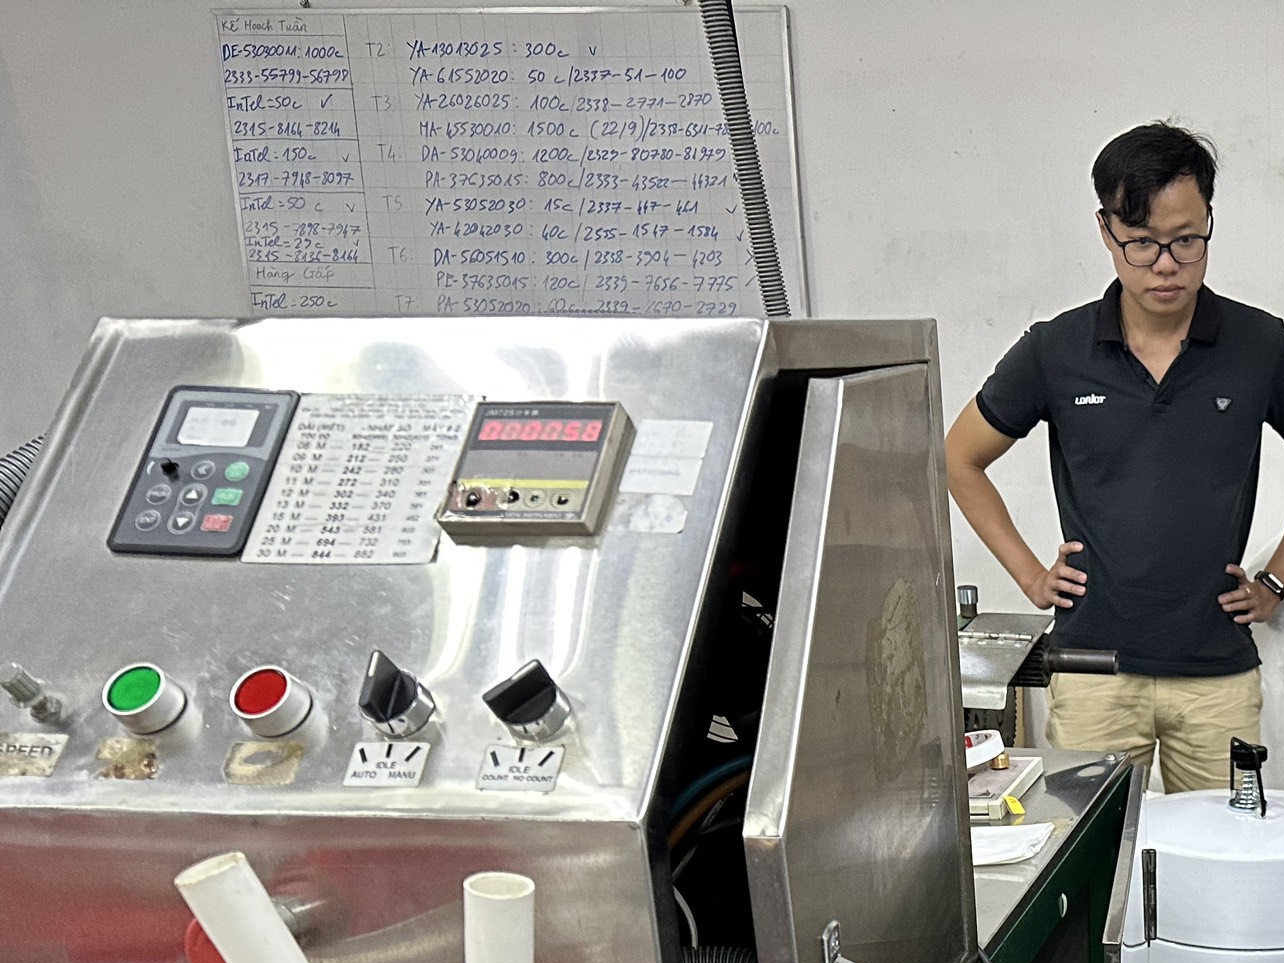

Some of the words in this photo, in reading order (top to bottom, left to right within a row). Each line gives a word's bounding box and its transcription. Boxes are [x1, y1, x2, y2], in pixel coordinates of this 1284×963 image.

[376, 761, 397, 769] IDLE
[509, 766, 530, 774] IDLE
[350, 771, 377, 779] AUTO
[387, 771, 415, 779] MANU
[482, 774, 509, 782] COUNT
[526, 775, 554, 783] COUNT
